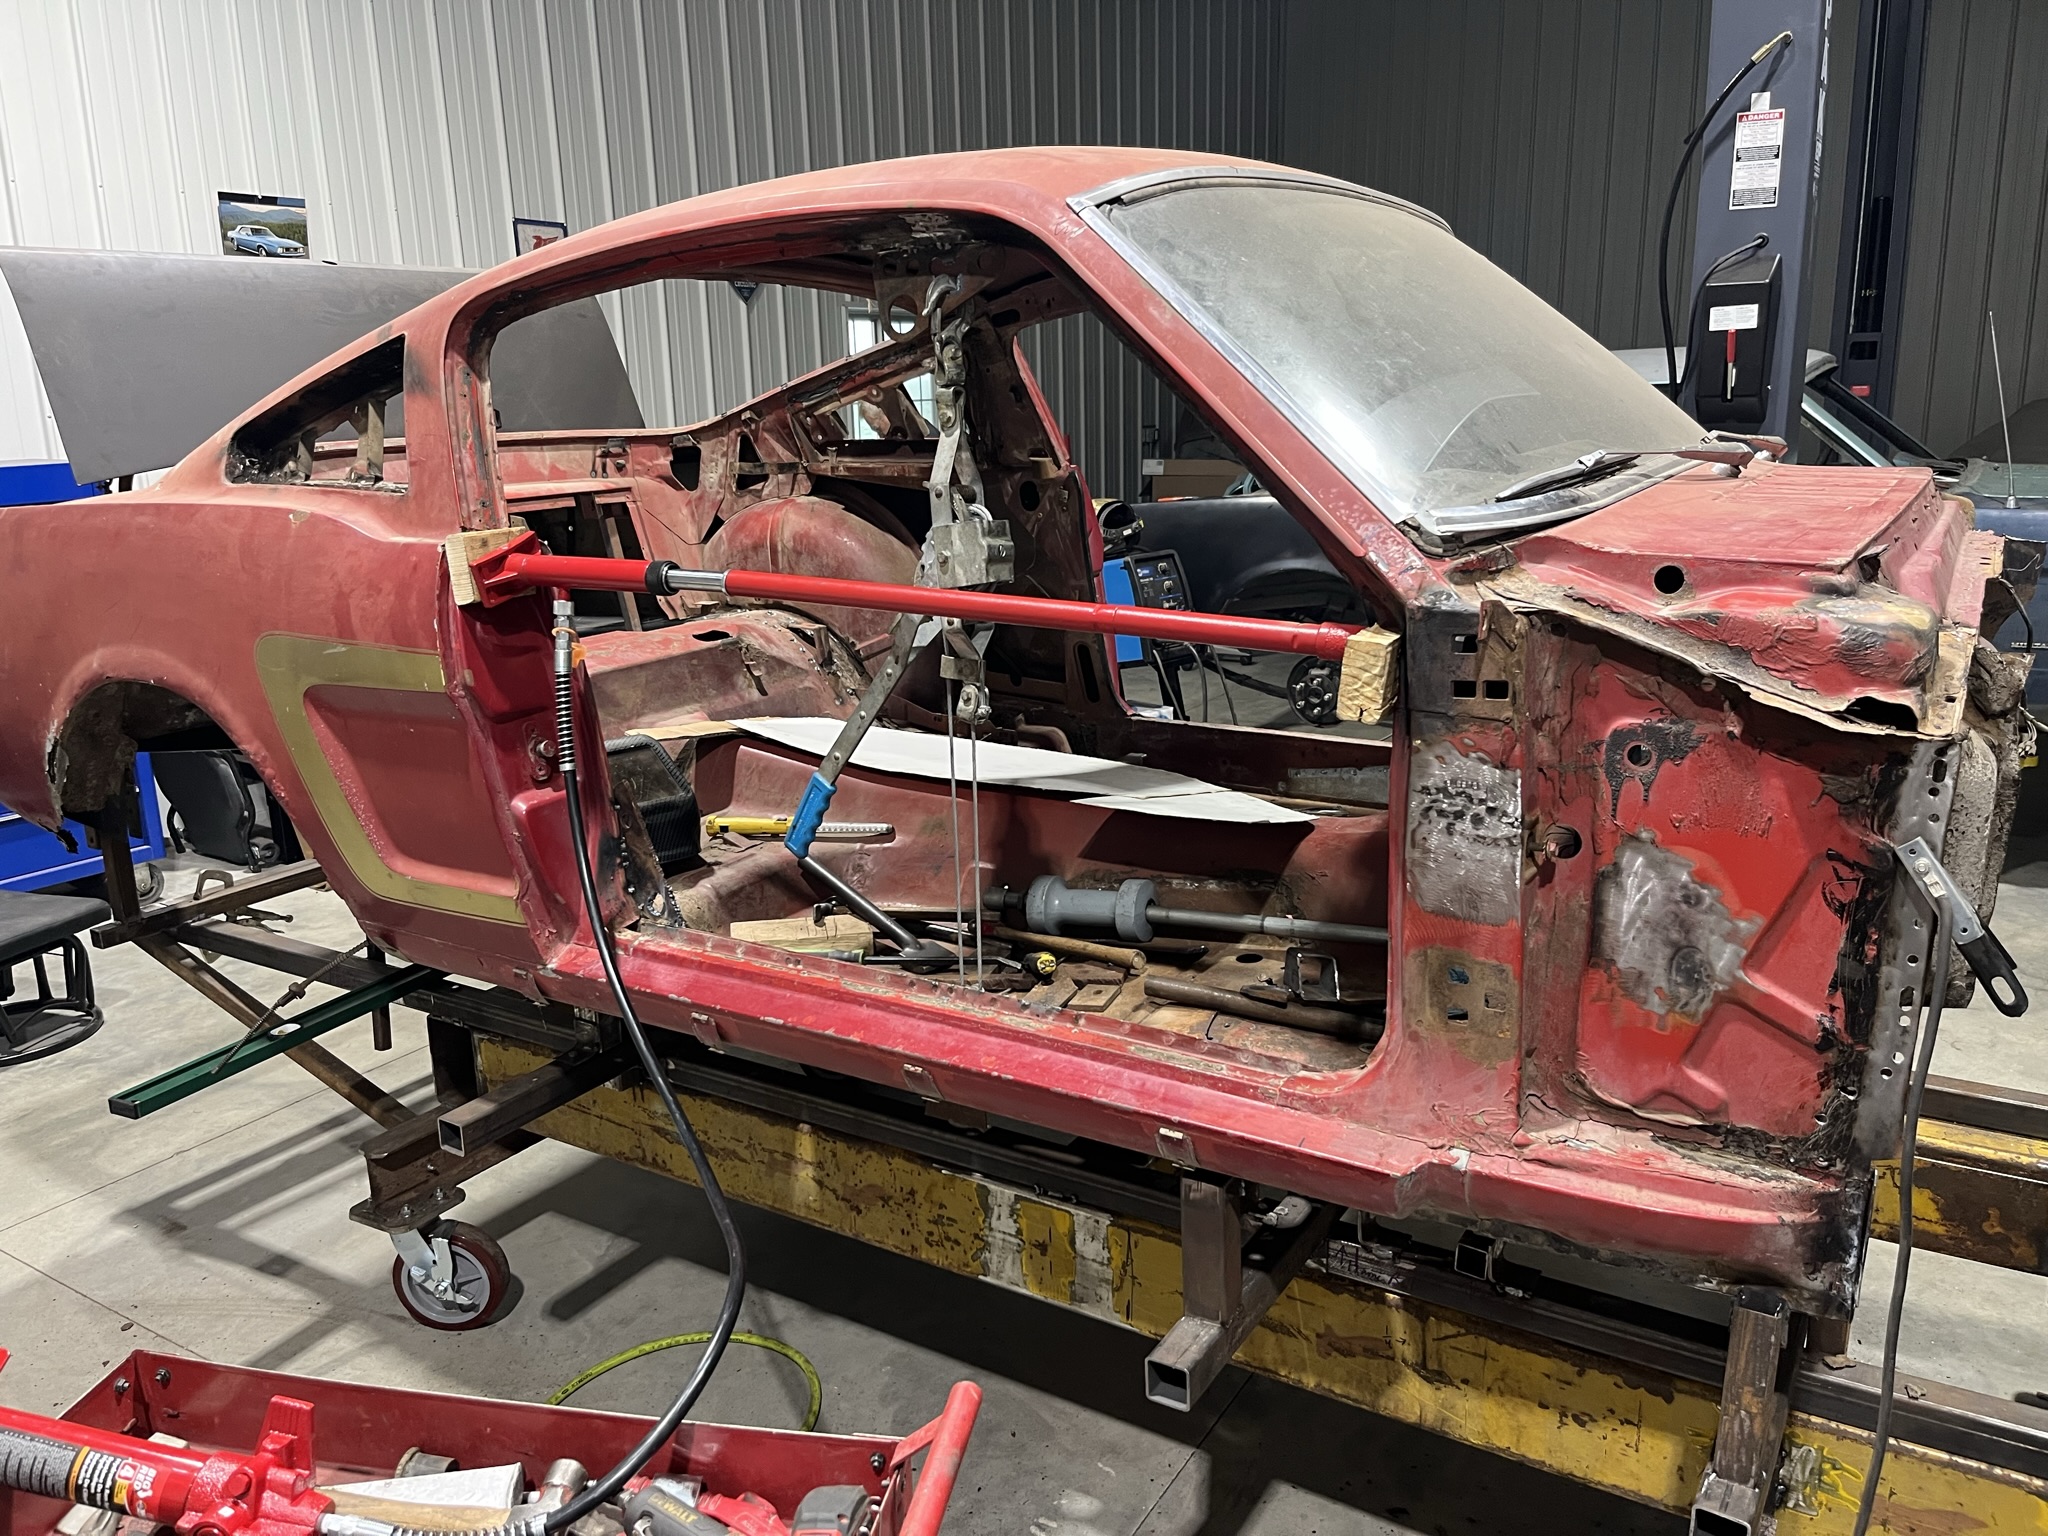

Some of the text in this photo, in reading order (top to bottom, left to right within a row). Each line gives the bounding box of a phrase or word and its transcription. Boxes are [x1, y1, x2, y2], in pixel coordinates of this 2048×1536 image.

[1747, 112, 1780, 121] DANGER
[119, 1464, 135, 1478] 4
[134, 1464, 149, 1490] RED
[142, 1467, 157, 1490] BIG
[648, 1491, 698, 1524] DEWALT
